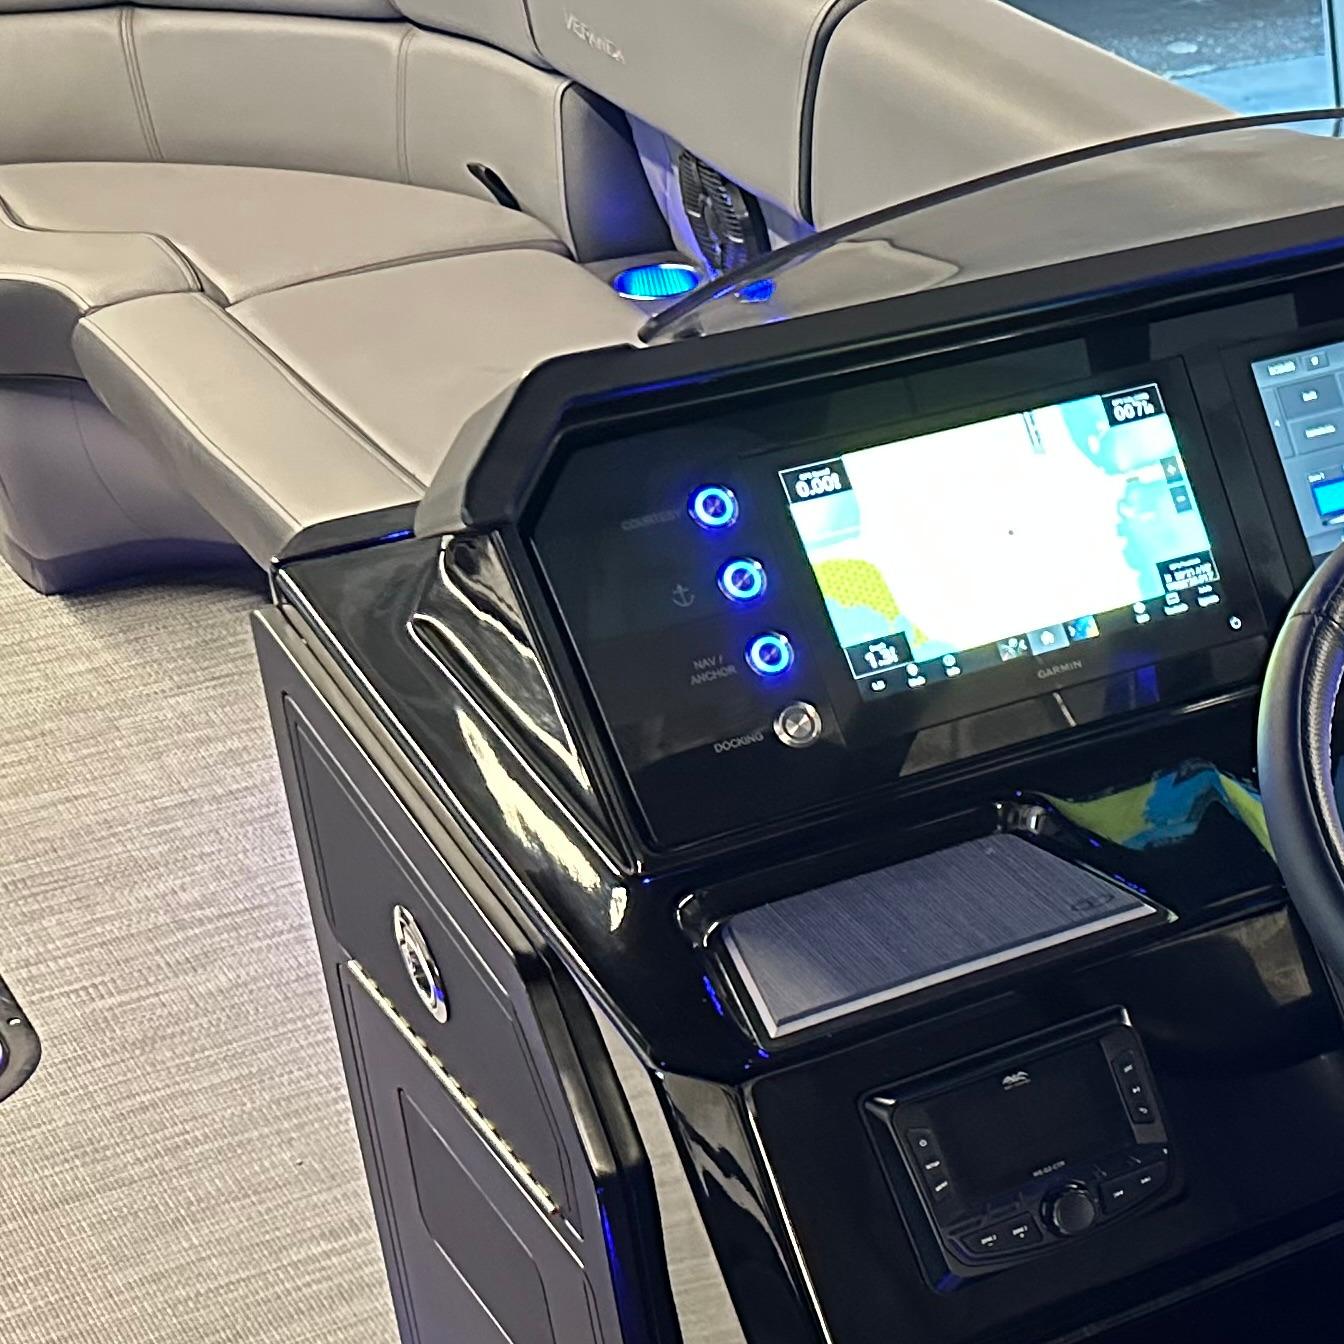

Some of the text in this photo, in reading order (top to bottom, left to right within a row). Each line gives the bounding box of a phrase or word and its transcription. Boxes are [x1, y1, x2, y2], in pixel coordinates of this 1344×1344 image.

[693, 656, 718, 671] NAV
[1037, 659, 1083, 680] GARMIN
[690, 664, 737, 686] ANCHOR
[713, 731, 765, 754] DOCKING
